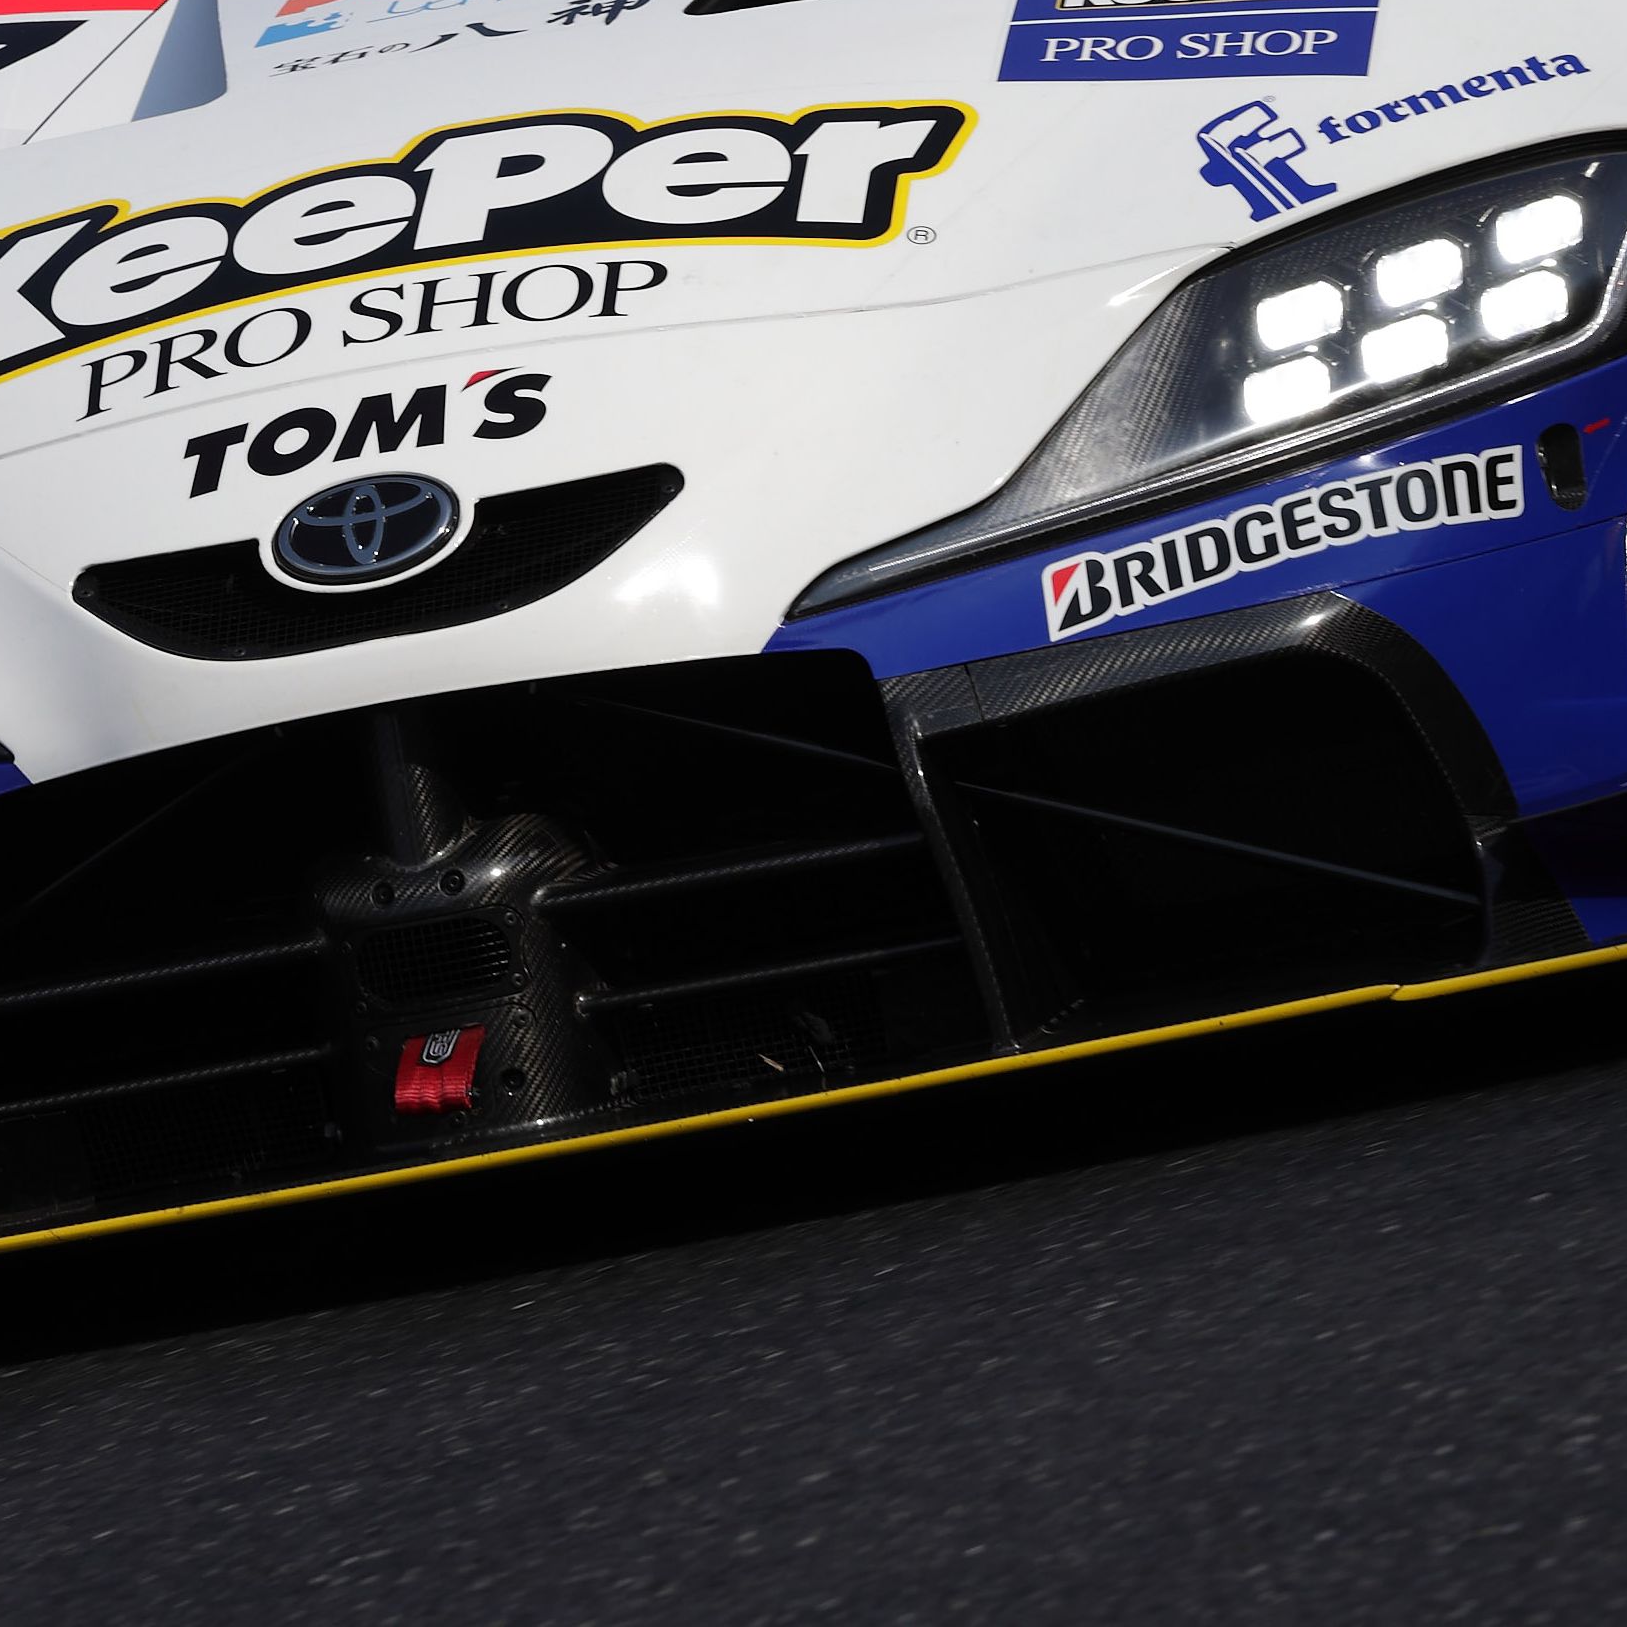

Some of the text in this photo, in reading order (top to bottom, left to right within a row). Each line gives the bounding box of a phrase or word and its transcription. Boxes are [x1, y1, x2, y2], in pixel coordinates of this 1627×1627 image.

[1040, 28, 1338, 64] PRO SHOP
[78, 260, 670, 424] PRO SHOP
[182, 368, 554, 500] TOM'S
[1048, 456, 1518, 636] BRIDGESTONE
